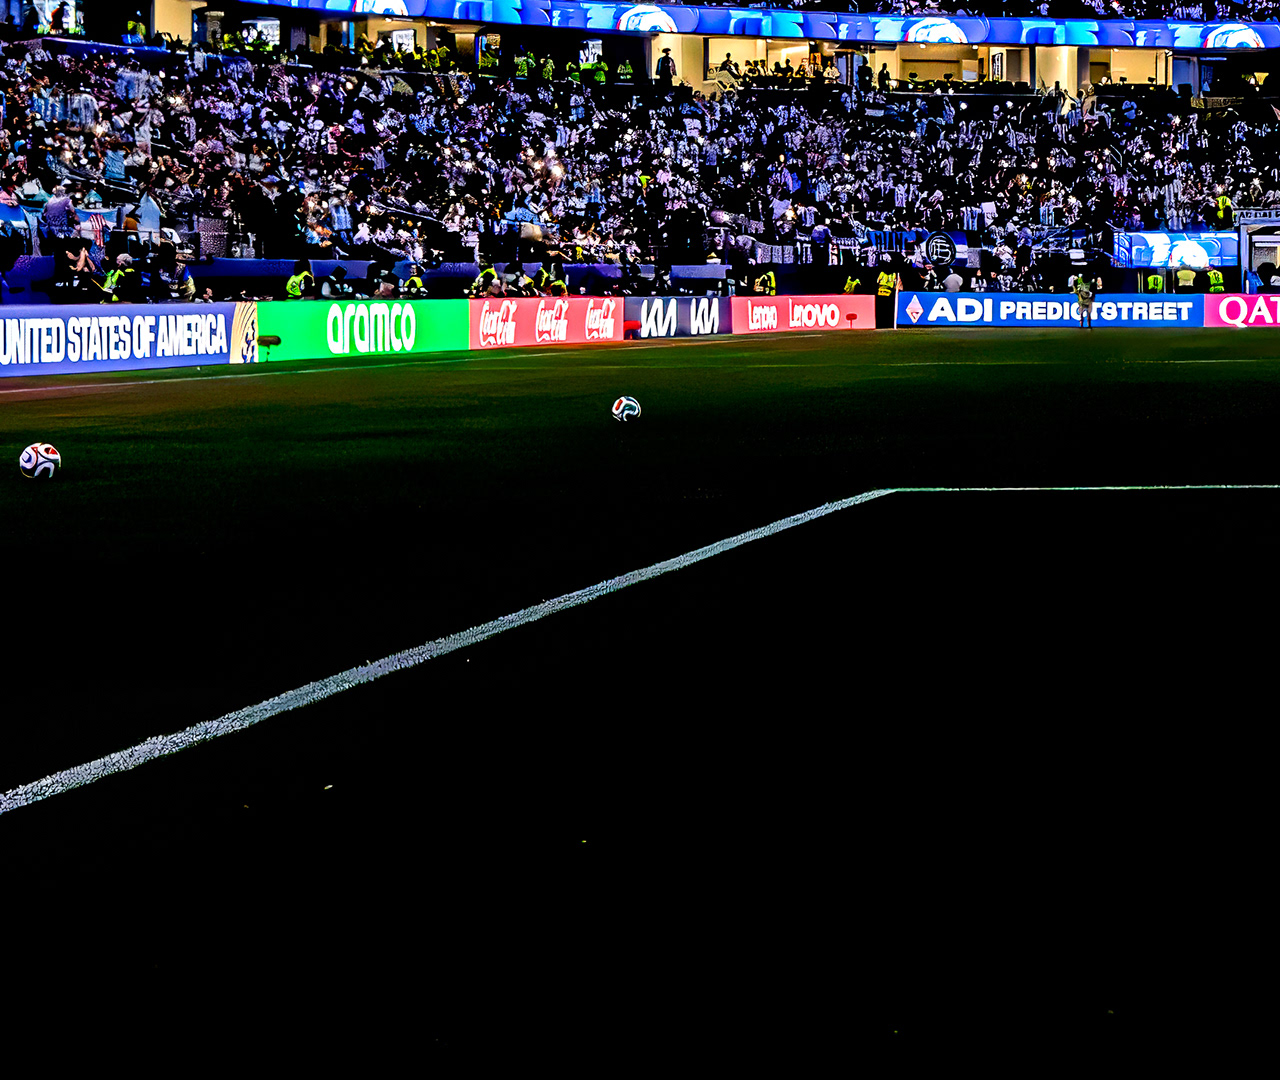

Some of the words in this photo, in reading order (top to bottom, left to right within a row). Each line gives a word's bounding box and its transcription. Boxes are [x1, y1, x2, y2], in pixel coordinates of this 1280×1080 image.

[327, 302, 416, 354] aramco
[927, 297, 993, 322] ADI
[0, 317, 66, 366] UNITED
[67, 316, 131, 362] STATES
[132, 315, 156, 360] OF
[156, 313, 228, 356] AMERICA
